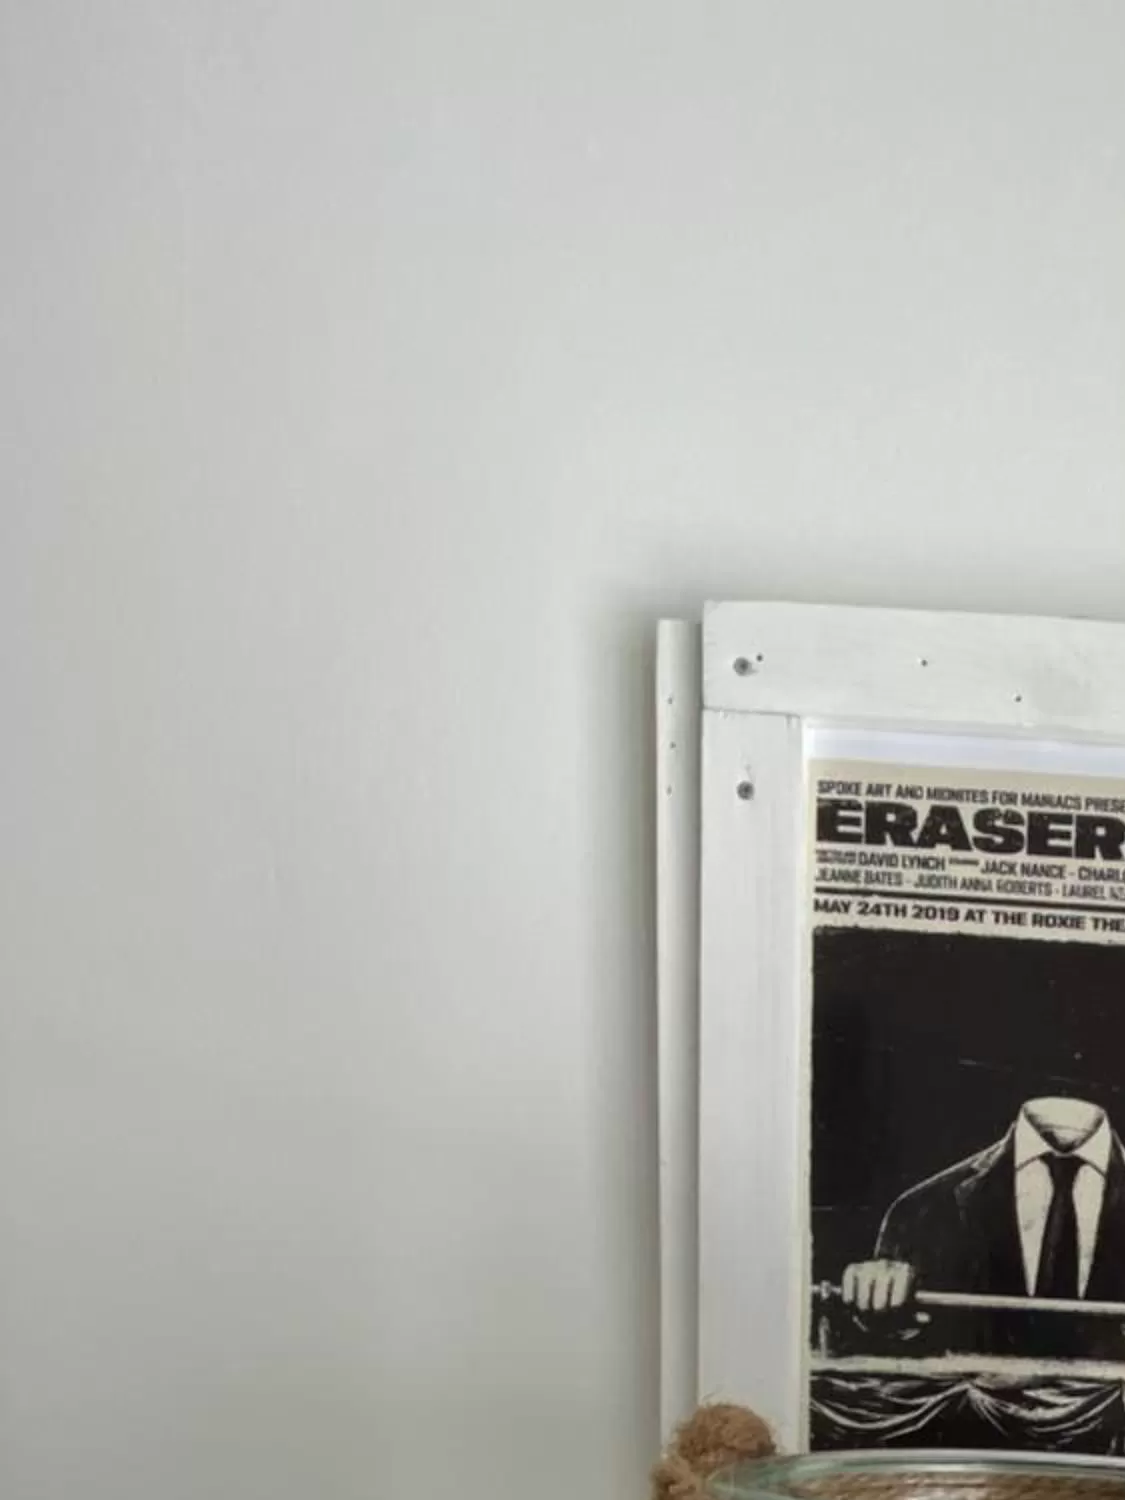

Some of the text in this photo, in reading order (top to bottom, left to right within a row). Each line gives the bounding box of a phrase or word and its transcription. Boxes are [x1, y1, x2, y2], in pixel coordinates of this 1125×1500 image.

[817, 780, 862, 797] SPOKE
[865, 782, 892, 798] ART
[896, 784, 923, 800] AND
[992, 790, 1019, 806] FOR
[815, 867, 862, 884] JEANNE
[858, 851, 899, 868] DAVID
[901, 853, 946, 871] LYNCH
[981, 859, 1017, 876] JACK
[1020, 862, 1066, 880] NANCE
[814, 898, 852, 914] MAY
[857, 900, 908, 918] 24TH
[912, 904, 961, 922] 2019
[964, 908, 986, 924] AT
[991, 910, 1028, 926] THE
[1031, 912, 1087, 930] ROXIE
